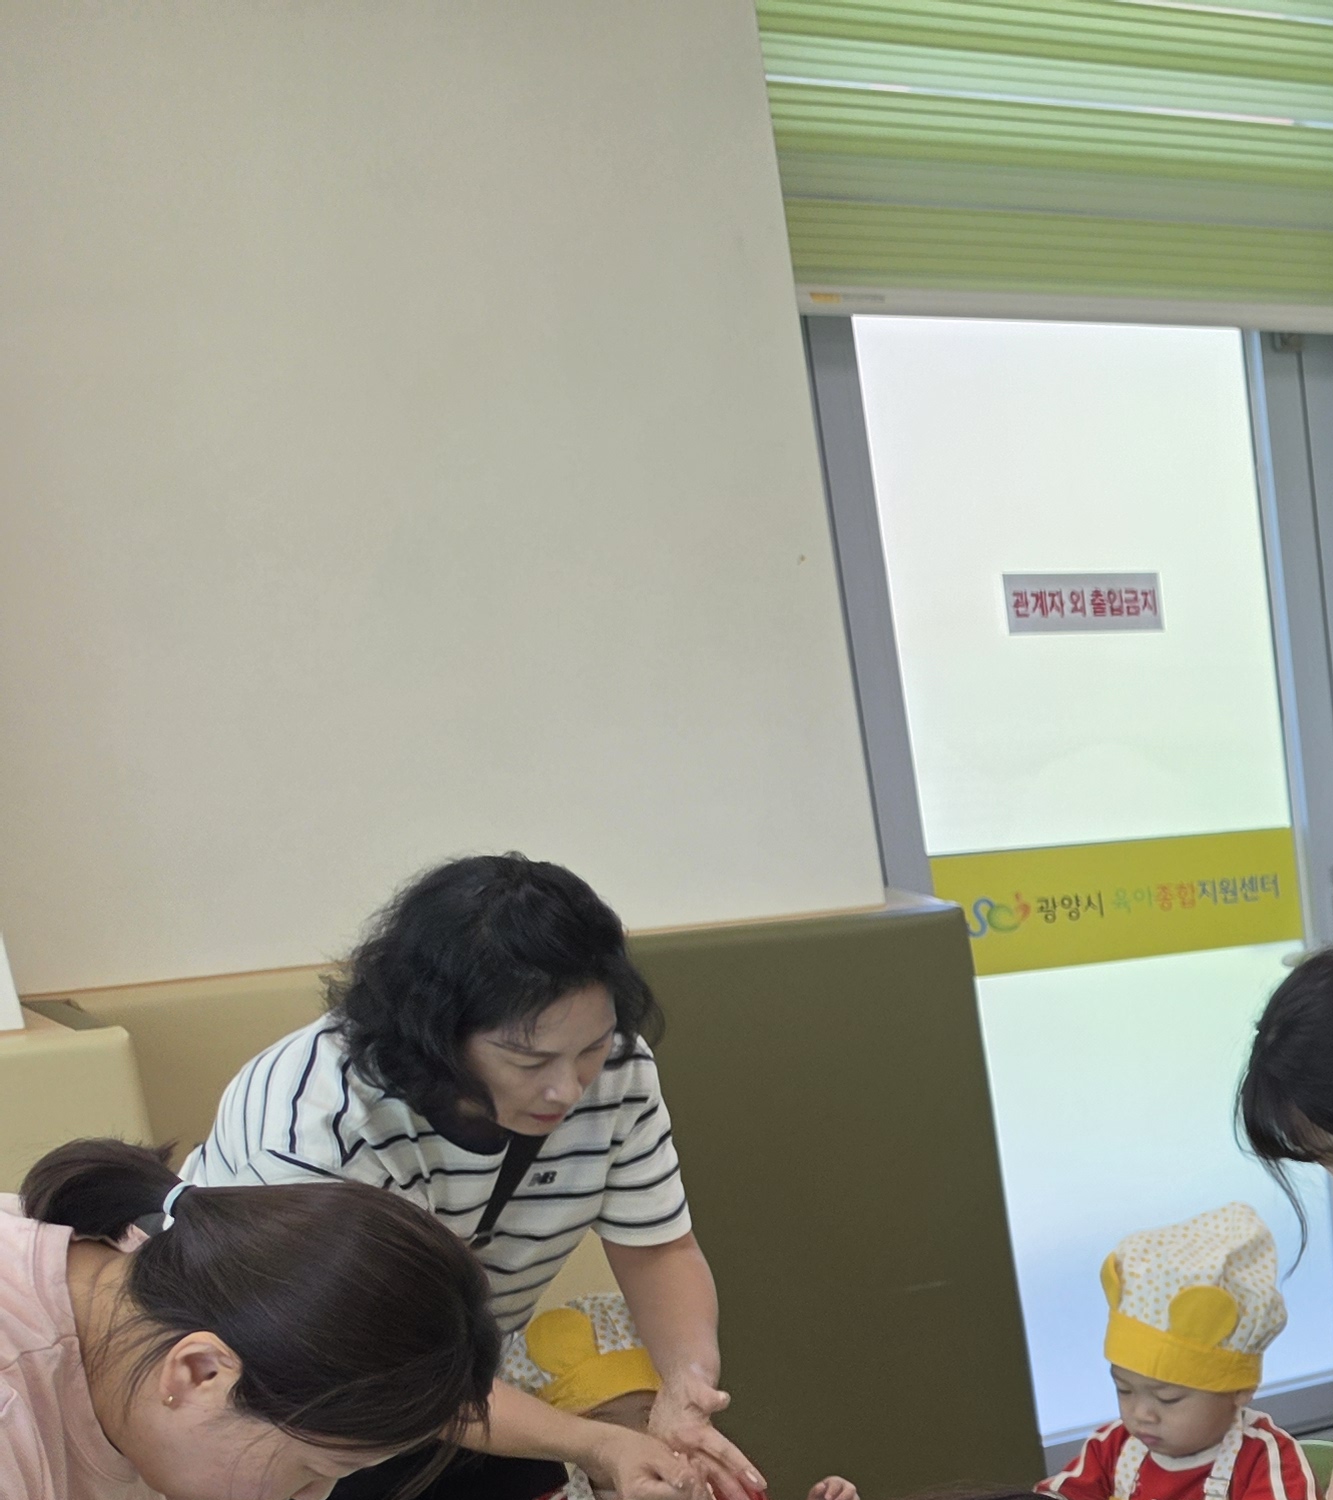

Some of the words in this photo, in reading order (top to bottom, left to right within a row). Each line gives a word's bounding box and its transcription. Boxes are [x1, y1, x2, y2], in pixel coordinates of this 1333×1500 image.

[1012, 588, 1065, 618] 관계자
[1069, 588, 1087, 618] 외
[1090, 587, 1158, 618] 출입금지
[1036, 890, 1105, 924] 광양시
